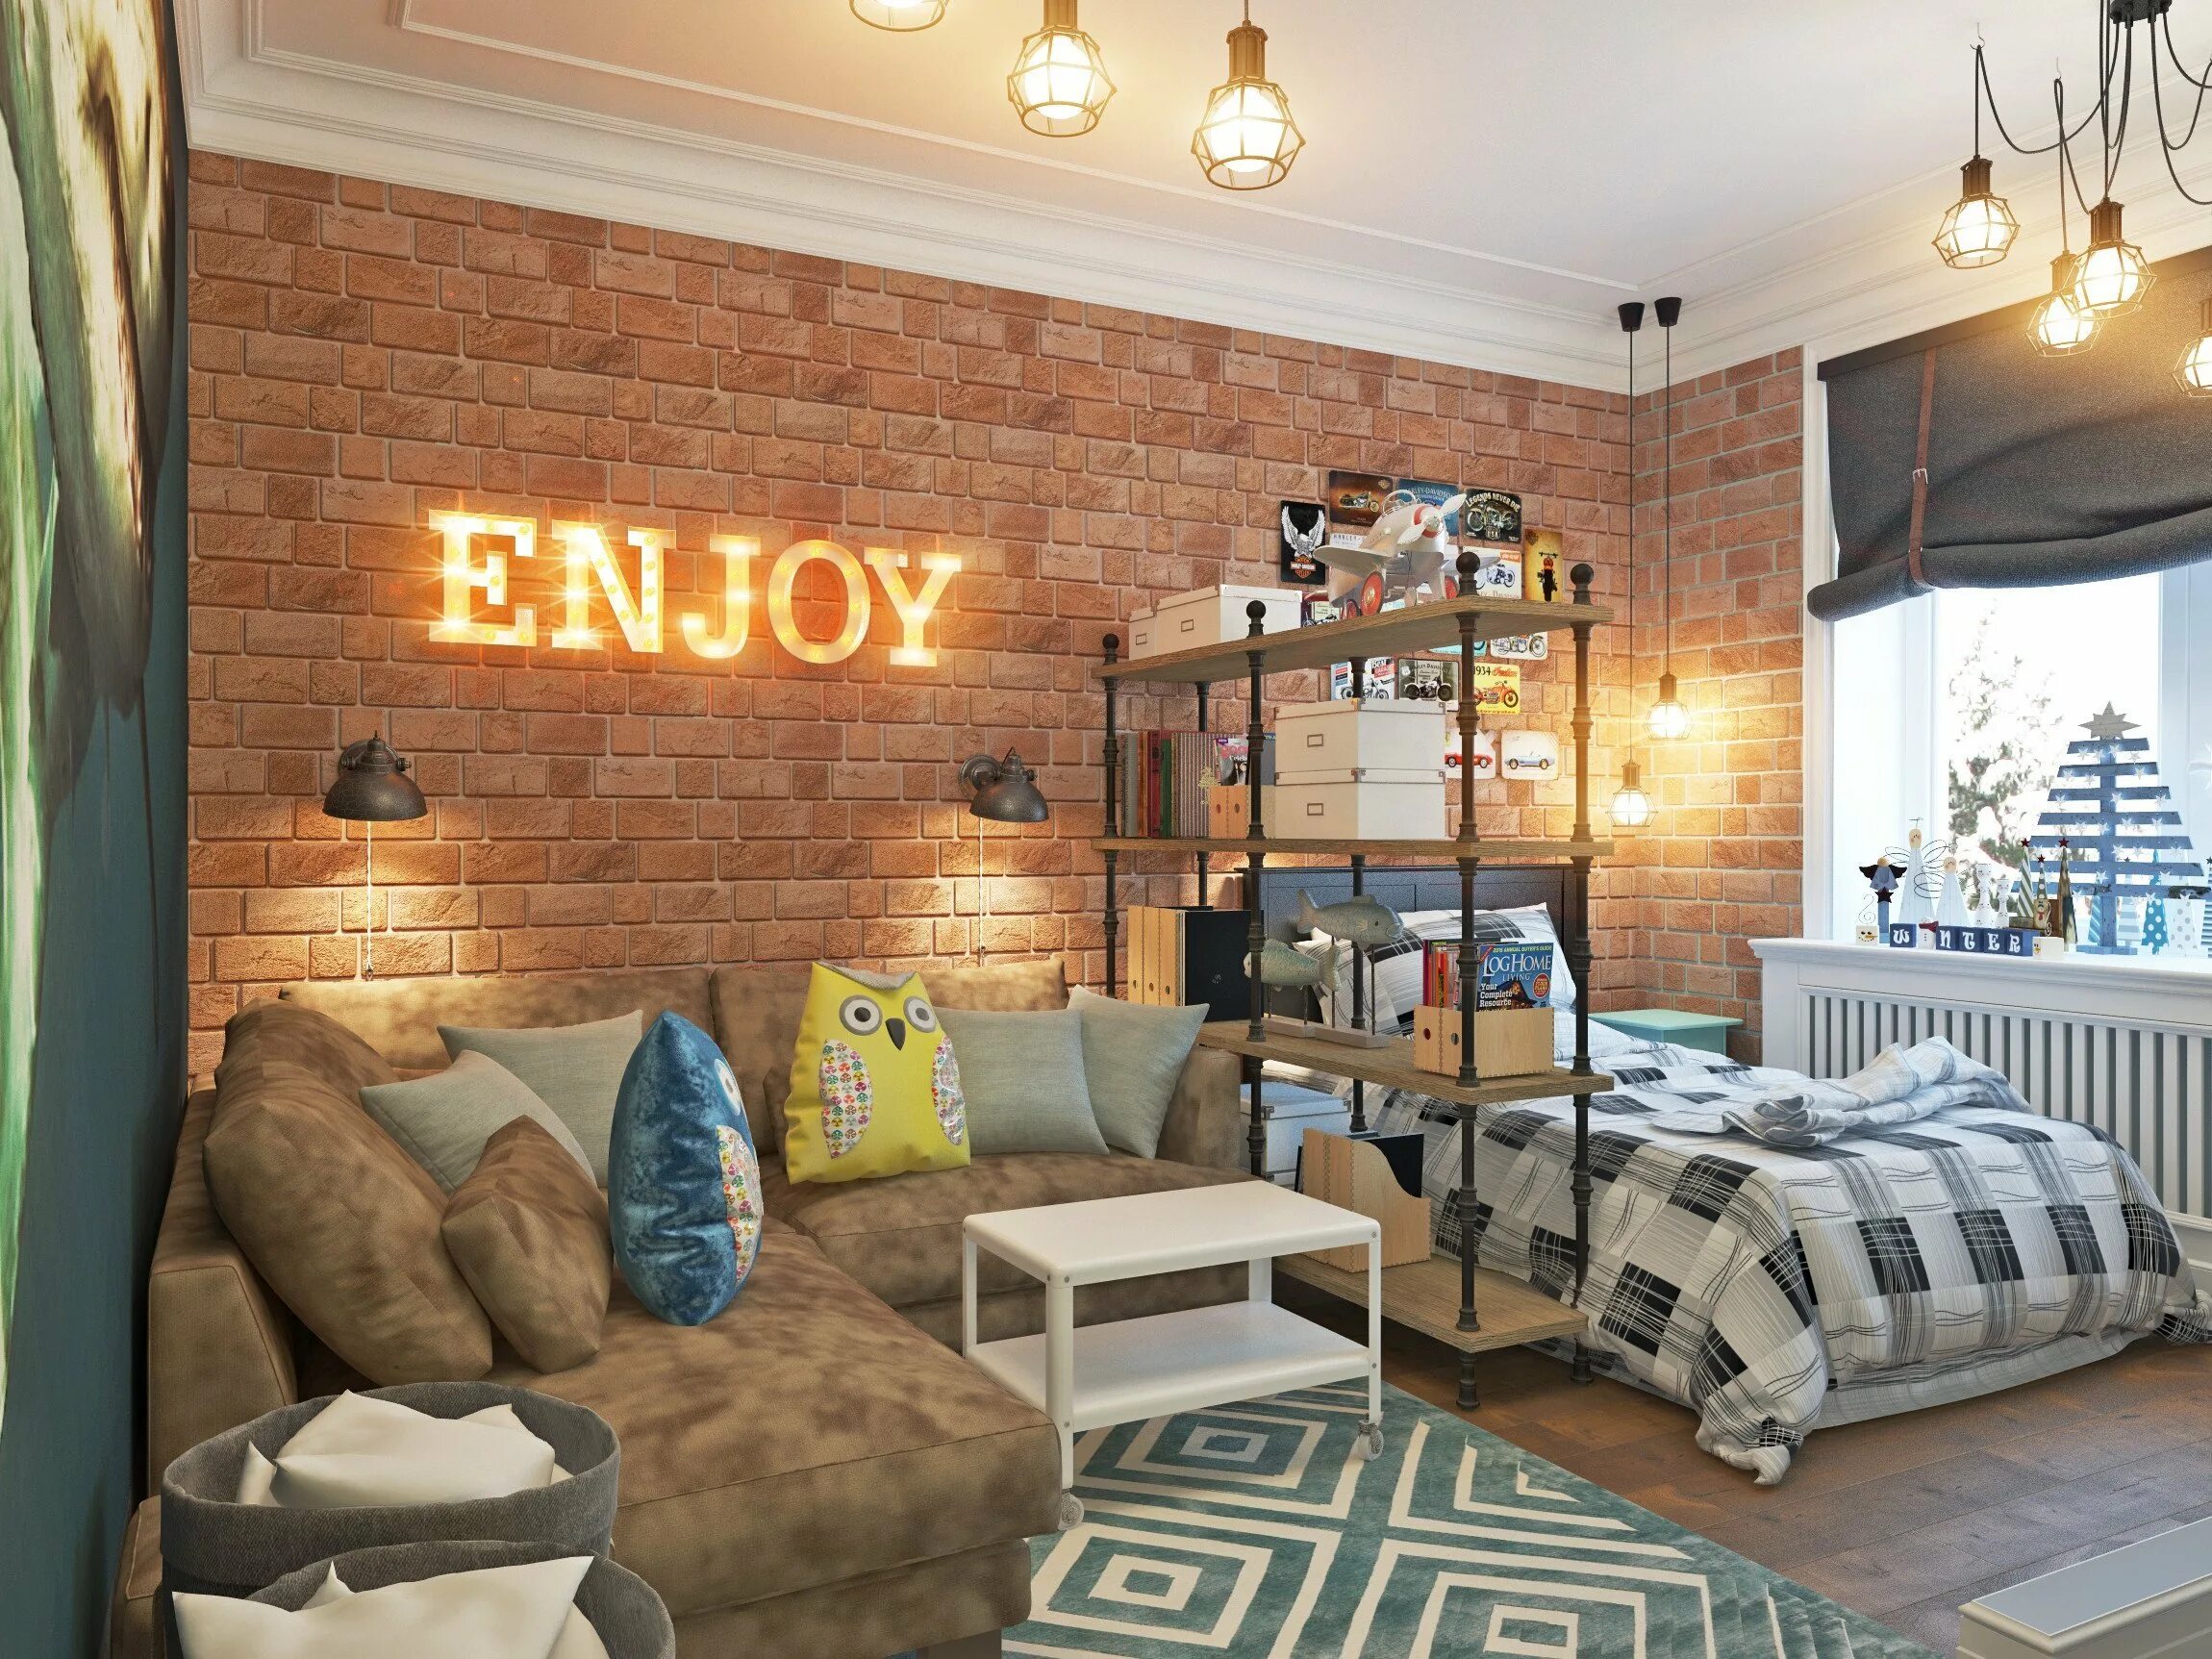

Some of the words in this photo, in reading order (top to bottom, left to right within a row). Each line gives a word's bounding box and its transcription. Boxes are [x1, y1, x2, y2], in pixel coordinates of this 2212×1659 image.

[1466, 492, 1492, 507] LEGENDS
[1492, 493, 1511, 506] NEVER
[1510, 500, 1521, 513] DIE
[429, 509, 962, 667] ENJOY
[1502, 972, 1531, 982] LIVING
[1480, 990, 1513, 999] Complete
